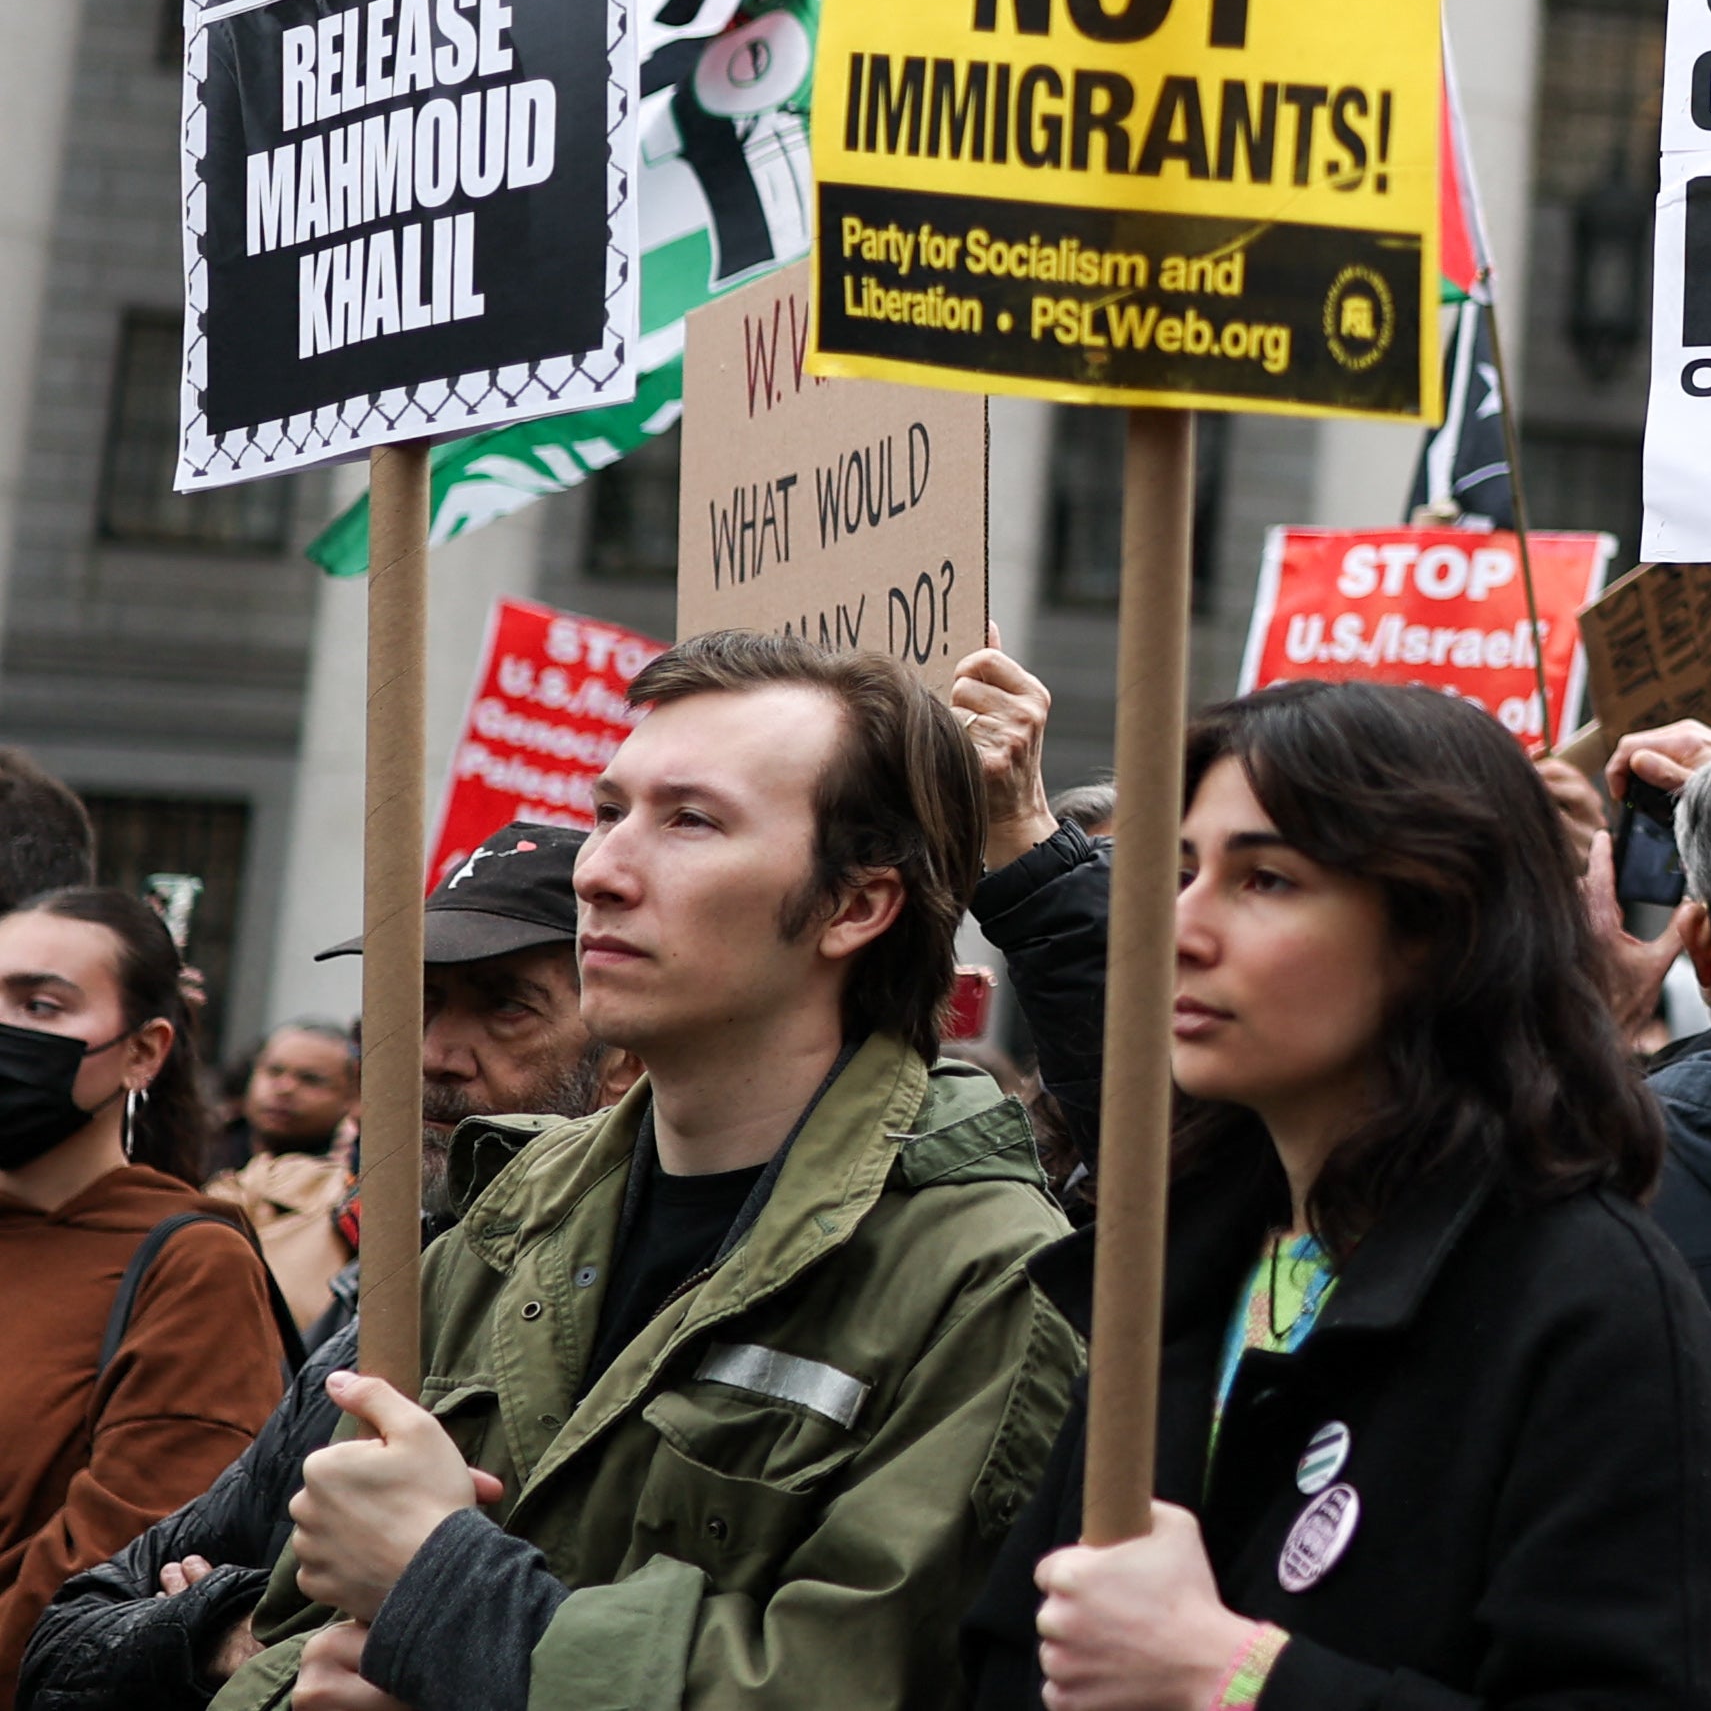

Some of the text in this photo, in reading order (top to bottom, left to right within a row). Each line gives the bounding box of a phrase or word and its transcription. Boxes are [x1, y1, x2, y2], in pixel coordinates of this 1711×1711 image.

[246, 78, 557, 257] MAHMOUD
[844, 51, 1393, 195] IMMIGRANTS!
[299, 211, 486, 360] KHALIL
[841, 217, 1246, 297] Party for Socialism and
[843, 275, 983, 333] Liberation
[1030, 295, 1292, 374] PSLWeb.org
[709, 472, 798, 591] WHAT
[816, 421, 930, 550] WOULD
[888, 559, 955, 666] DO?
[1337, 543, 1517, 602] STOP
[544, 616, 674, 682] STO
